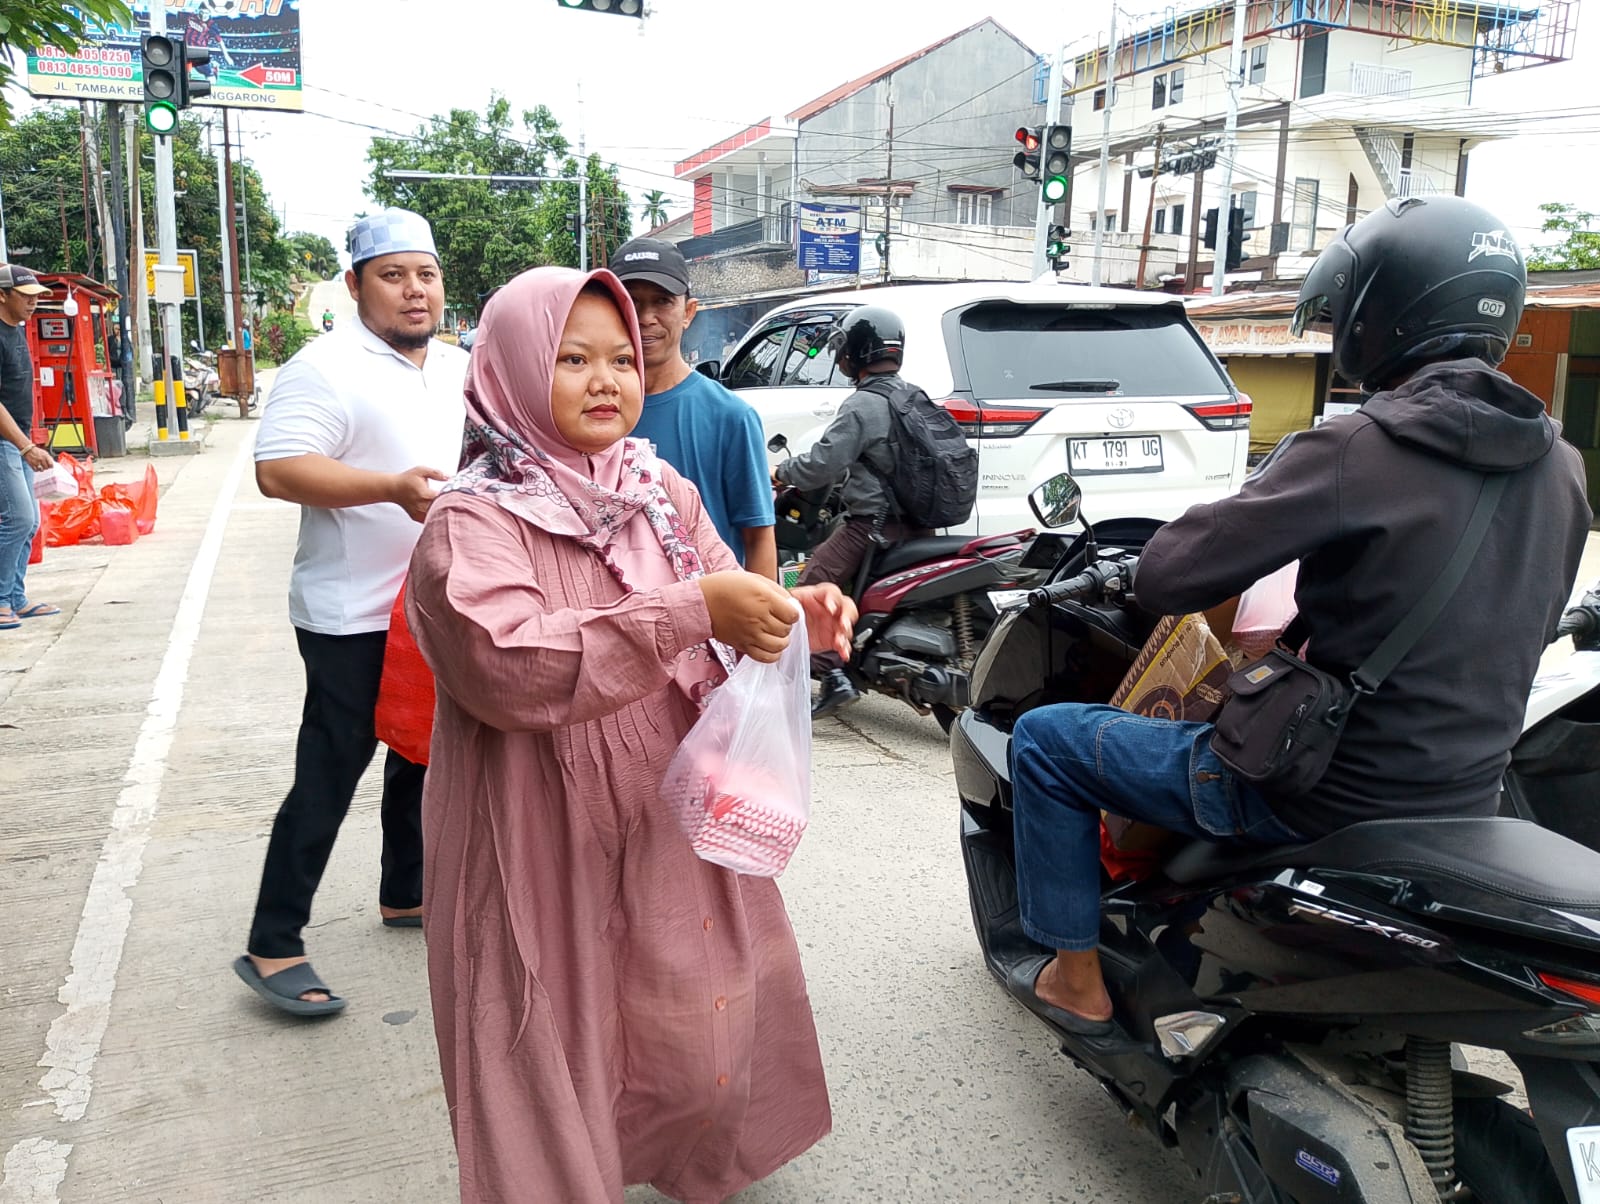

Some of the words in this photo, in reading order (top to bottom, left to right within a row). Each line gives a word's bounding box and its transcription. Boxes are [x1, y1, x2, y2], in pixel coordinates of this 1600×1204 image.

[71, 48, 98, 60] 805
[102, 50, 130, 63] 8250
[38, 61, 67, 73] 0813
[70, 63, 99, 75] 4859
[102, 65, 132, 77] 5090
[265, 71, 291, 82] 50M
[75, 83, 125, 95] TAMBAK
[202, 91, 276, 103] NGGARONG
[816, 217, 846, 227] ATM
[1481, 301, 1504, 315] DOT
[1072, 441, 1088, 460] KT
[1102, 440, 1128, 459] 1791
[1141, 439, 1159, 457] UG
